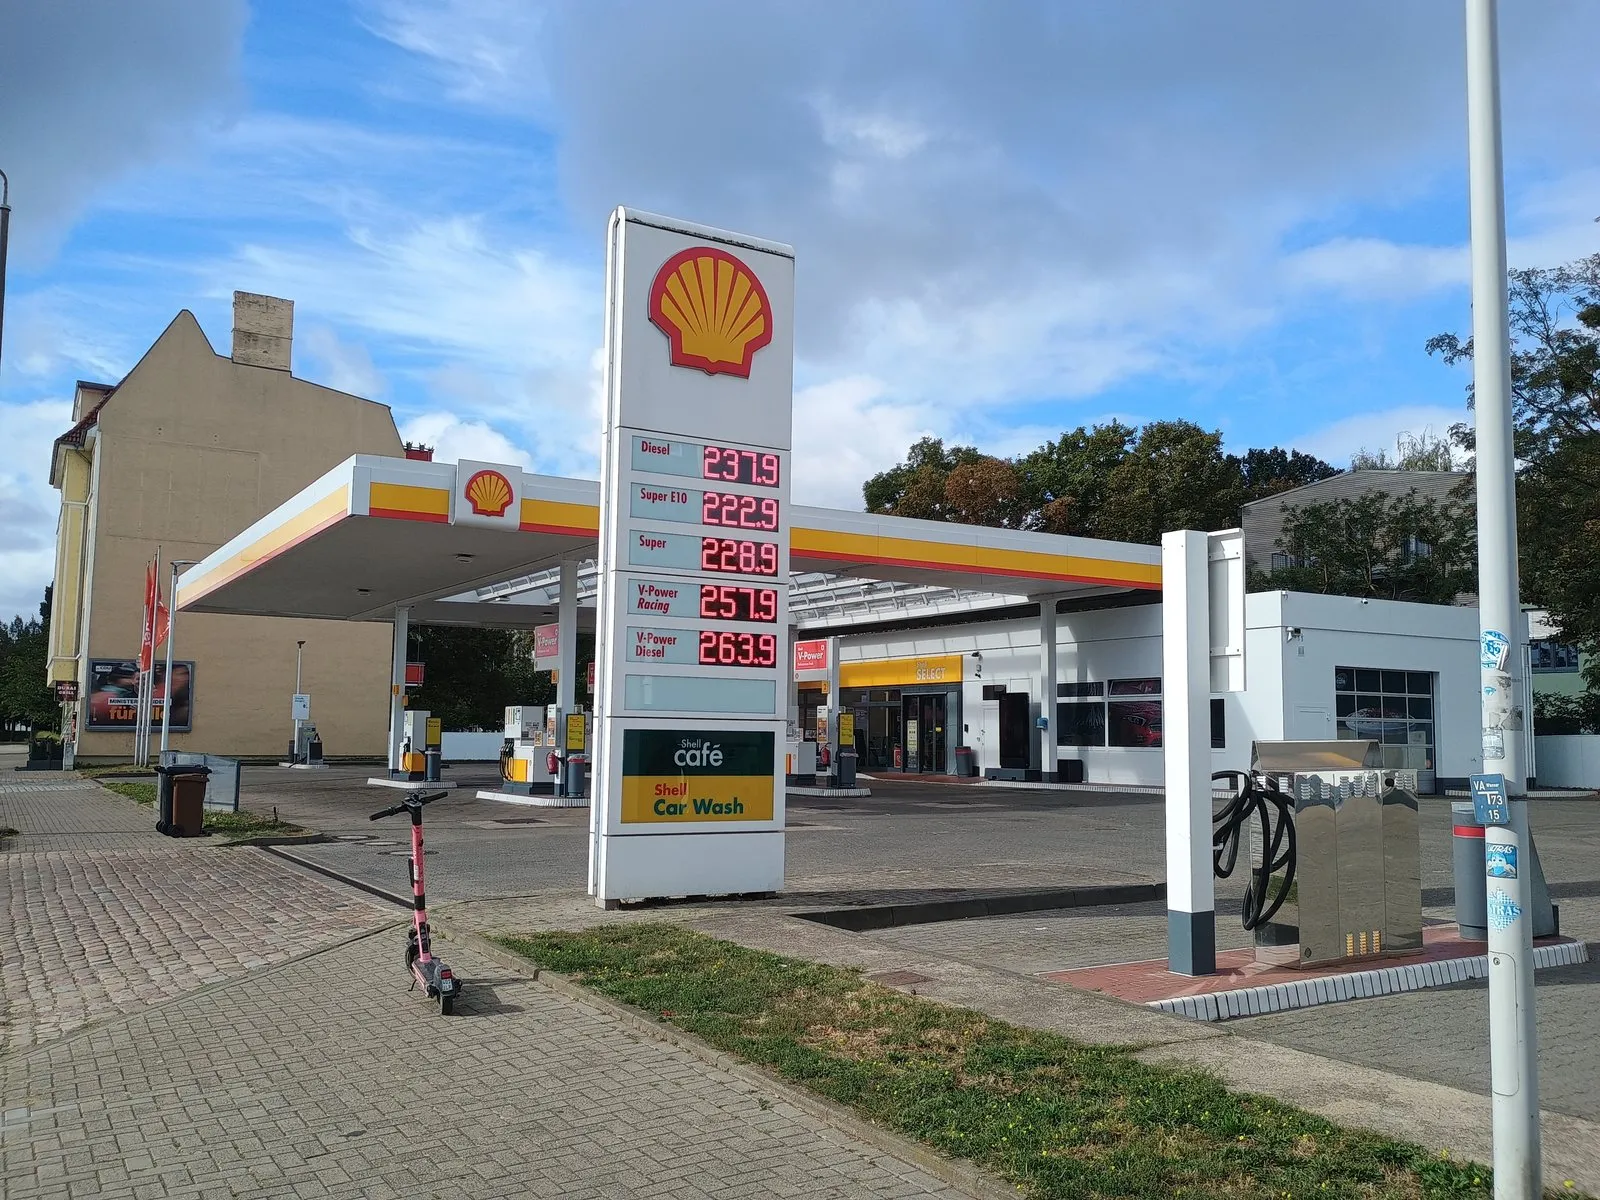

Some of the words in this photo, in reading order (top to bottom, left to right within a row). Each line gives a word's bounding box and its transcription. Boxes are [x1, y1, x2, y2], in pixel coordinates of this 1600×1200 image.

[641, 440, 670, 456] Diesel
[703, 446, 778, 485] 237.9
[640, 488, 667, 502] Super
[670, 491, 687, 504] E10
[702, 492, 777, 530] 222.9
[639, 535, 666, 551] Super
[702, 538, 777, 574] 228.9
[637, 584, 678, 599] V-Power
[637, 598, 670, 614] Racing
[701, 585, 776, 620] 257.9
[636, 631, 677, 646] V-Power
[635, 645, 665, 658] Diesel
[700, 631, 775, 665] 263.9
[798, 651, 824, 660] V-Power
[916, 667, 946, 680] SELECT
[109, 705, 137, 720] für
[681, 739, 701, 749] Shell
[673, 742, 724, 767] café
[654, 783, 688, 796] Shell
[1473, 780, 1486, 791] VA
[653, 799, 688, 815] Car
[692, 797, 744, 815] Wash
